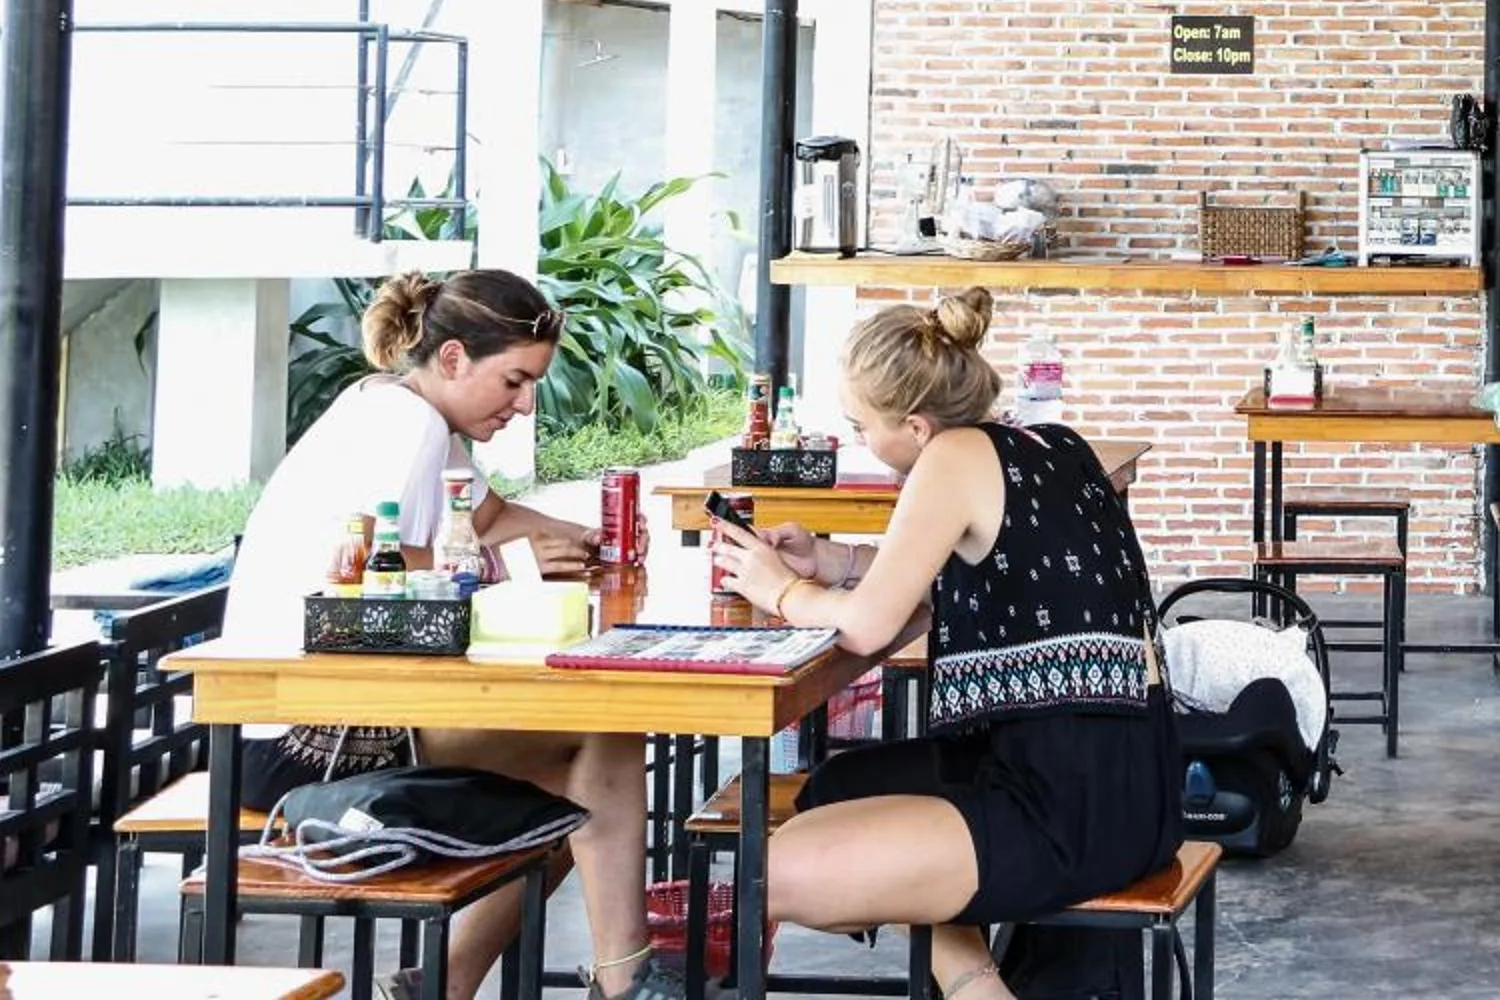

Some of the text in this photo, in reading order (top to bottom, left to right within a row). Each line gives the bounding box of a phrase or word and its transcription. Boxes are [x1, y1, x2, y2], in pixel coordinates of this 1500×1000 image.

[1174, 24, 1241, 43] Open: 7am
[1174, 48, 1251, 66] Close: 10pm
